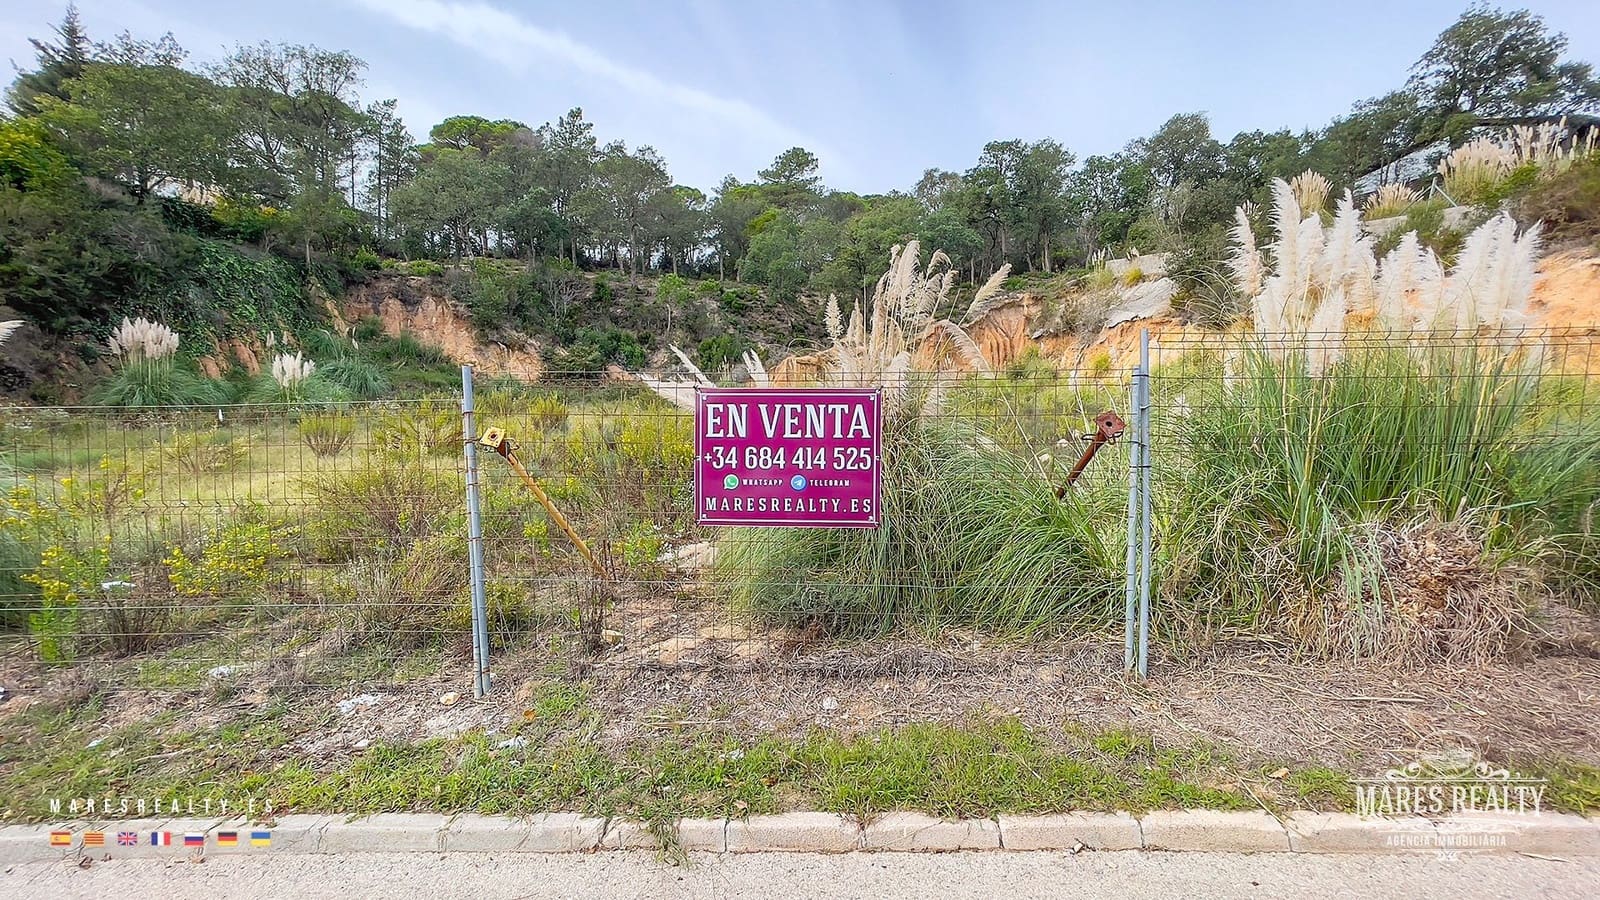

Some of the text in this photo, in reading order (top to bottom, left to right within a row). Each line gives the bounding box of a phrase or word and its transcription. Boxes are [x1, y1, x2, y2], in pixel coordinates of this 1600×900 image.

[705, 403, 871, 438] EN VENTA
[704, 446, 871, 470] +34 684 414 525
[809, 479, 850, 487] TELEGRAM
[705, 497, 871, 512] MARESREALTY.ES
